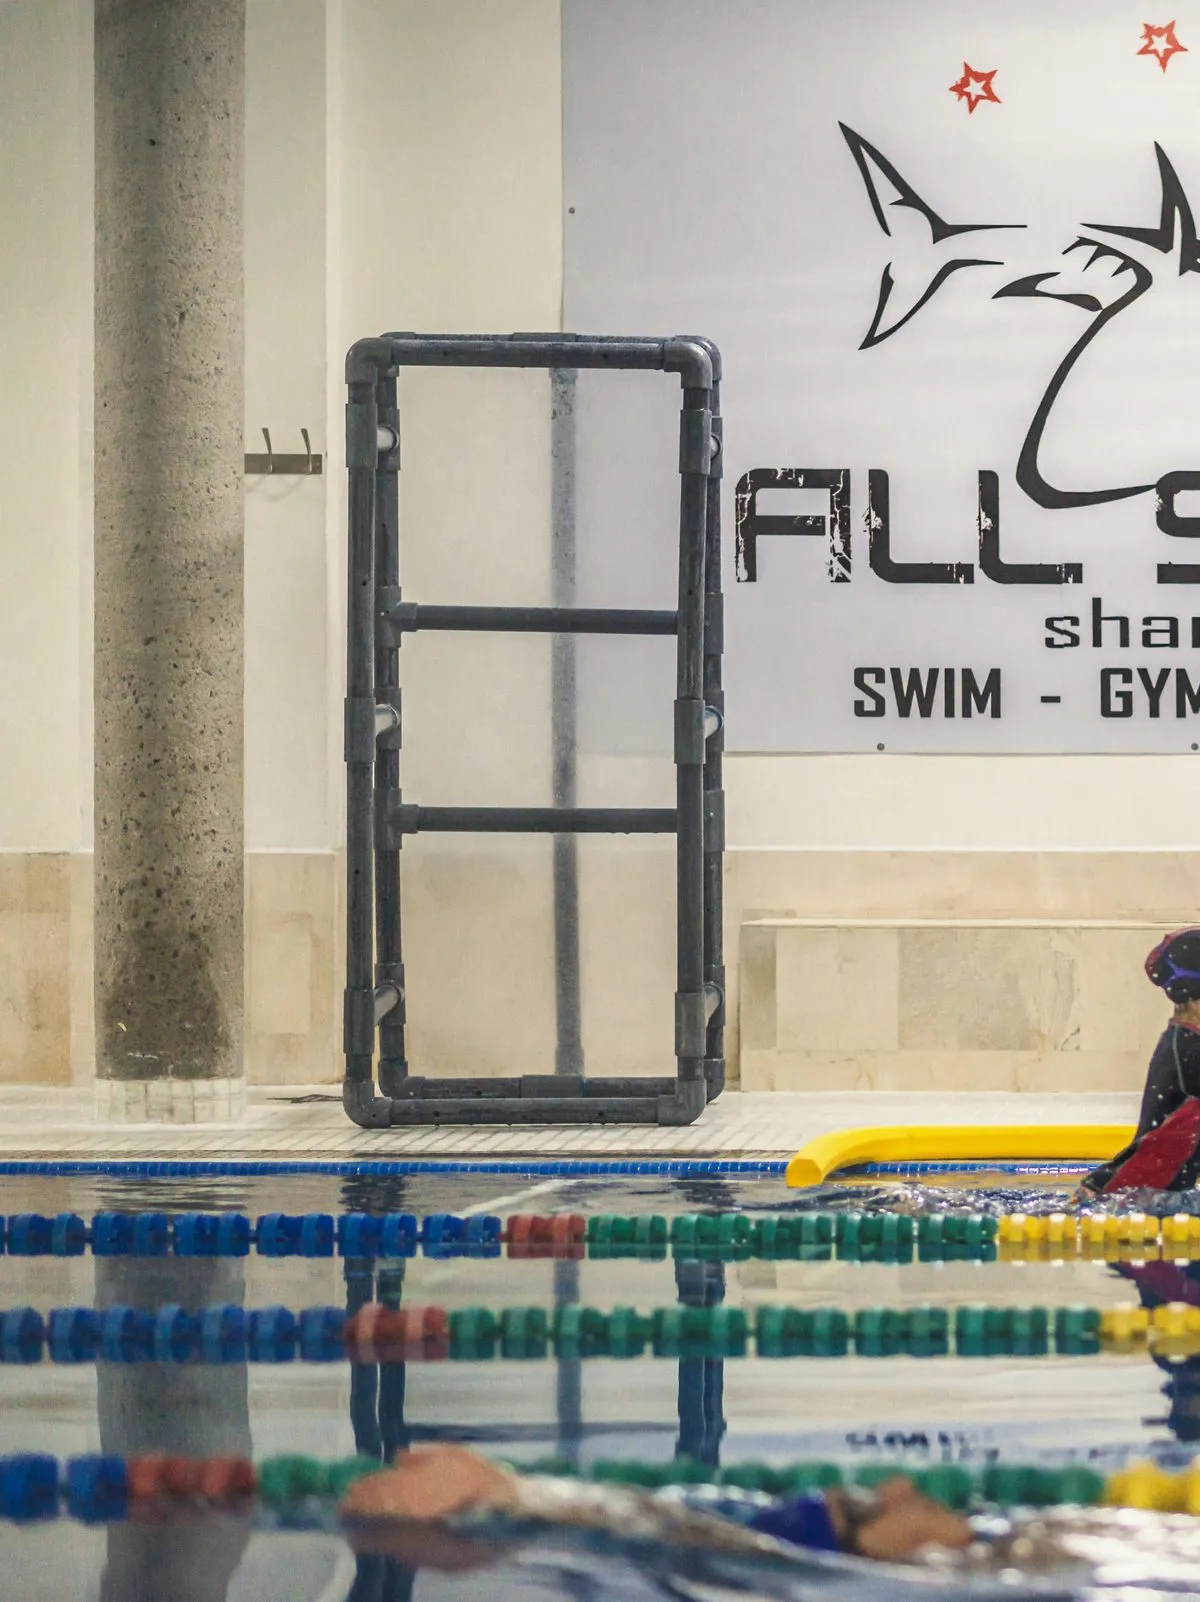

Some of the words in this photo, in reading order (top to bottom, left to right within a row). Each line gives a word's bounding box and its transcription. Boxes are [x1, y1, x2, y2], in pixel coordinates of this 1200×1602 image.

[735, 468, 1083, 584] ALL
[854, 667, 1002, 719] SWIM
[1041, 695, 1061, 704] -
